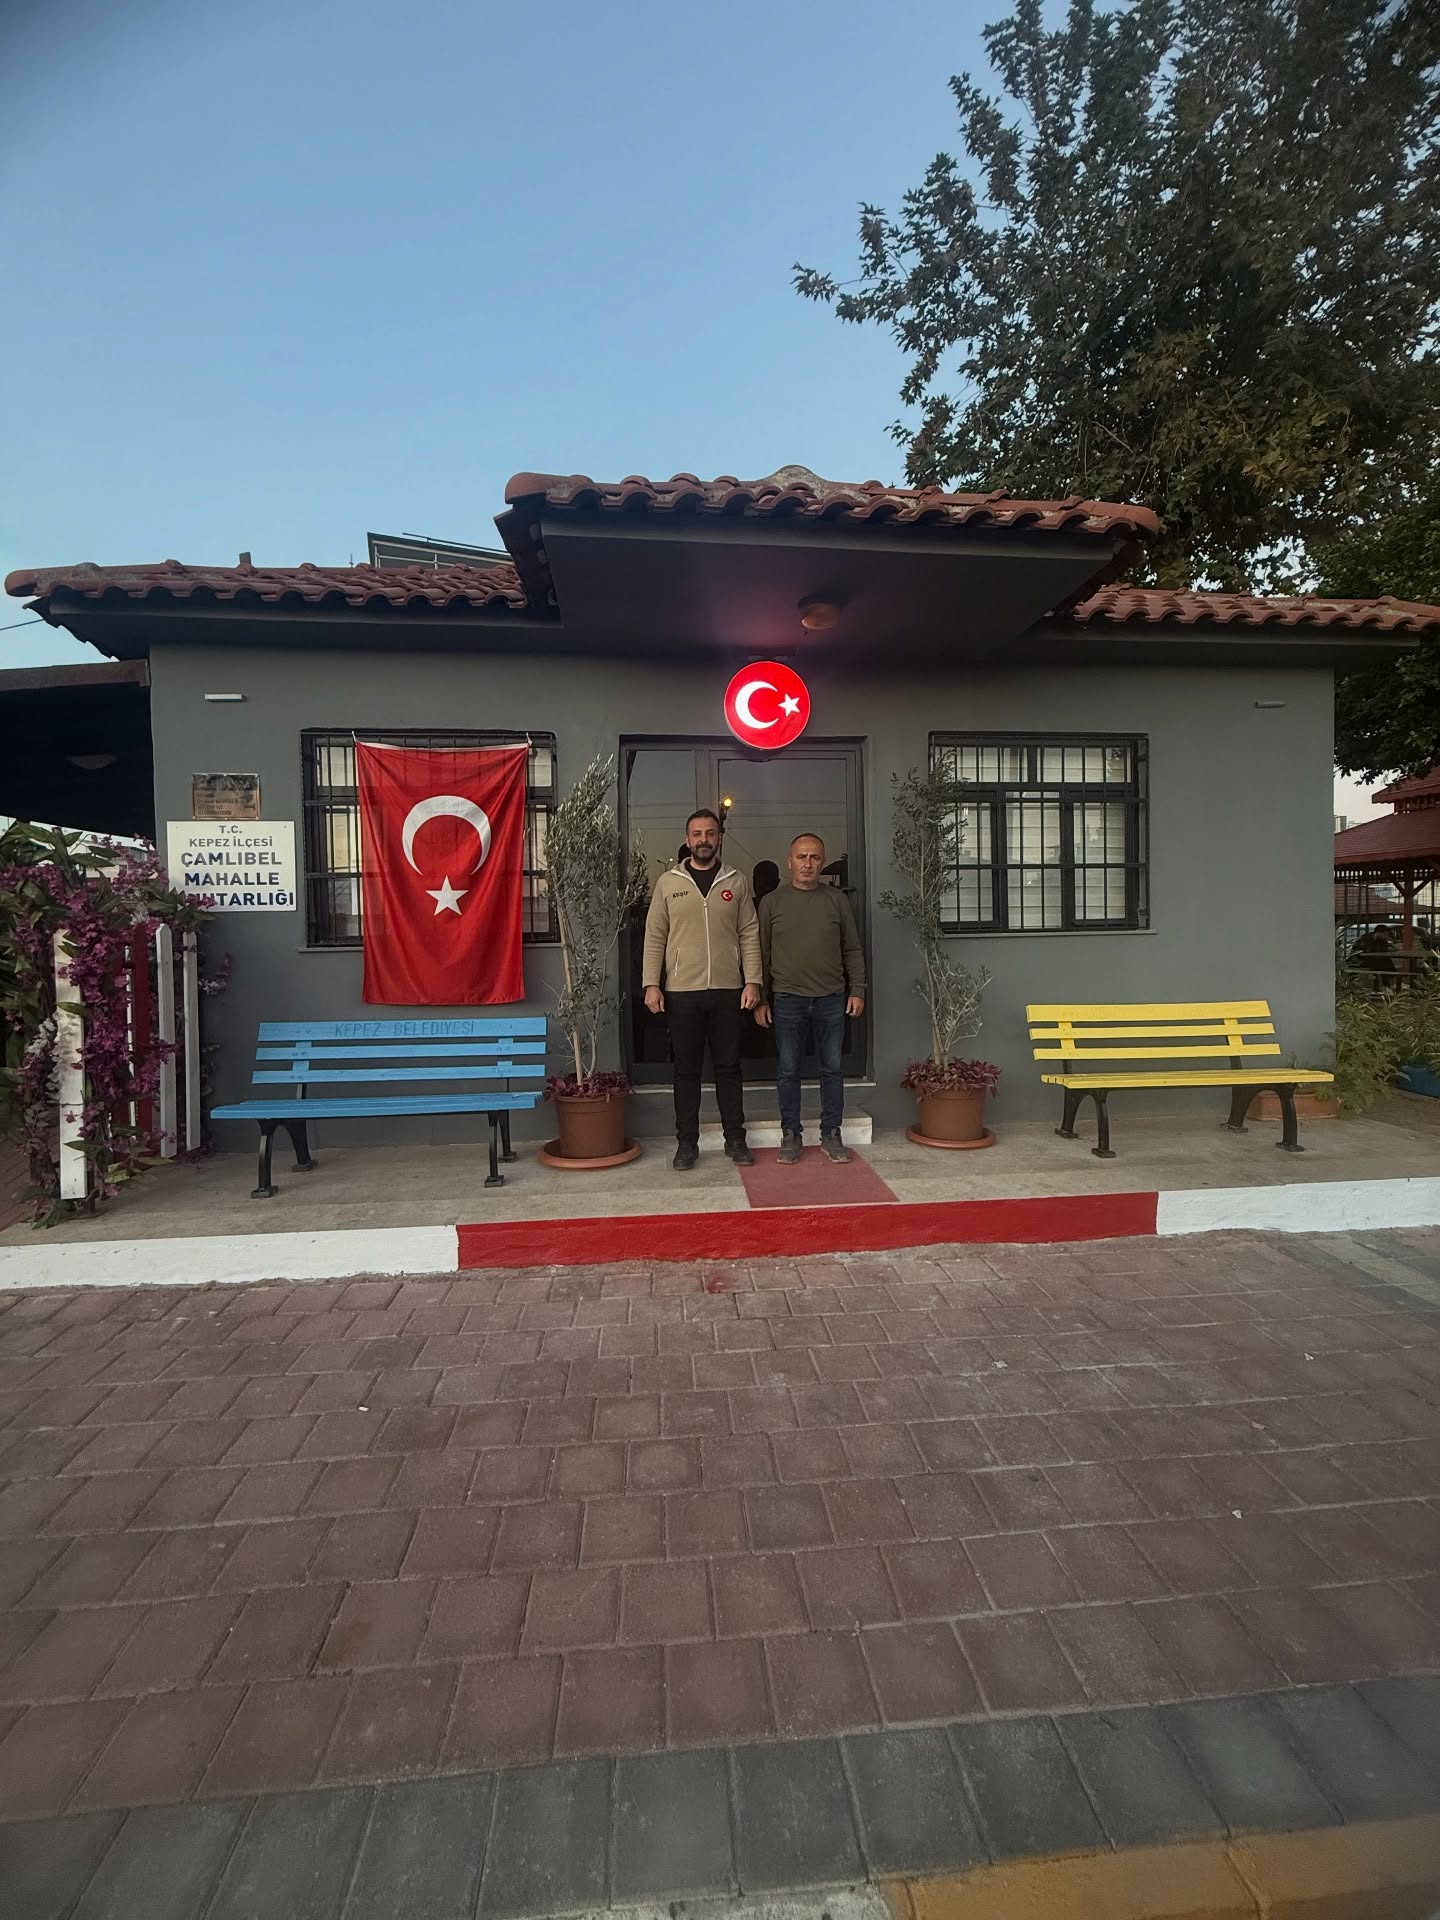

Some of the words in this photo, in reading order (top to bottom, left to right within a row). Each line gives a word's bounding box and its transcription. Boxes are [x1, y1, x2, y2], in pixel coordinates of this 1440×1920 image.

[218, 825, 243, 834] T.C.
[189, 838, 230, 847] KEPEZ
[233, 835, 273, 848] İLÇESİ
[181, 852, 282, 867] ÇAMLIBEL
[184, 872, 280, 886] MAHALLE
[335, 1022, 382, 1038] KEPEZ
